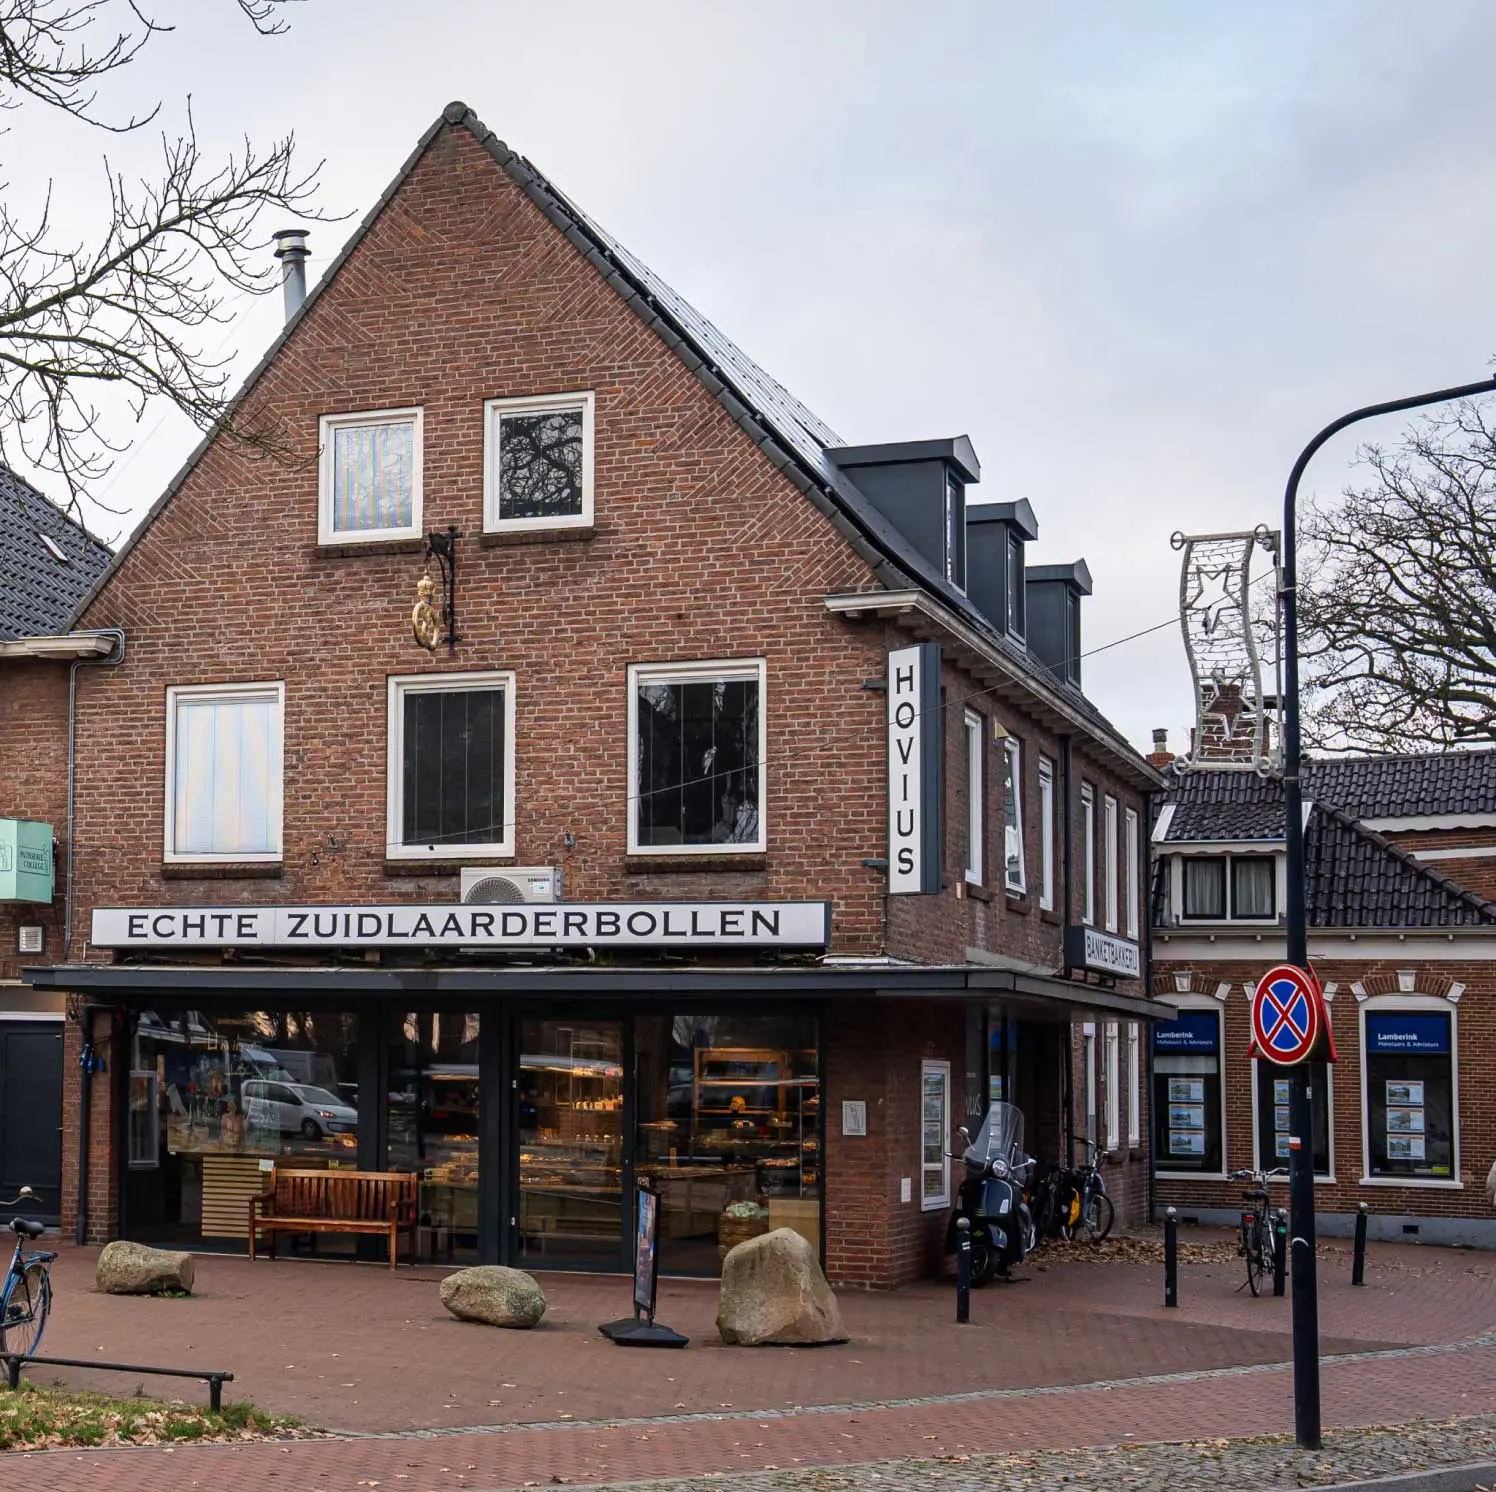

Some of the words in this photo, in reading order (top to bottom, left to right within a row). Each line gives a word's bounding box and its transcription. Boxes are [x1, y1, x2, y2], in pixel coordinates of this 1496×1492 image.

[895, 664, 915, 875] HOVIUS
[127, 914, 258, 938] ECHTE
[287, 910, 781, 938] ZUIDLAARDERBOLLEN
[1377, 1033, 1418, 1041] Lamberink
